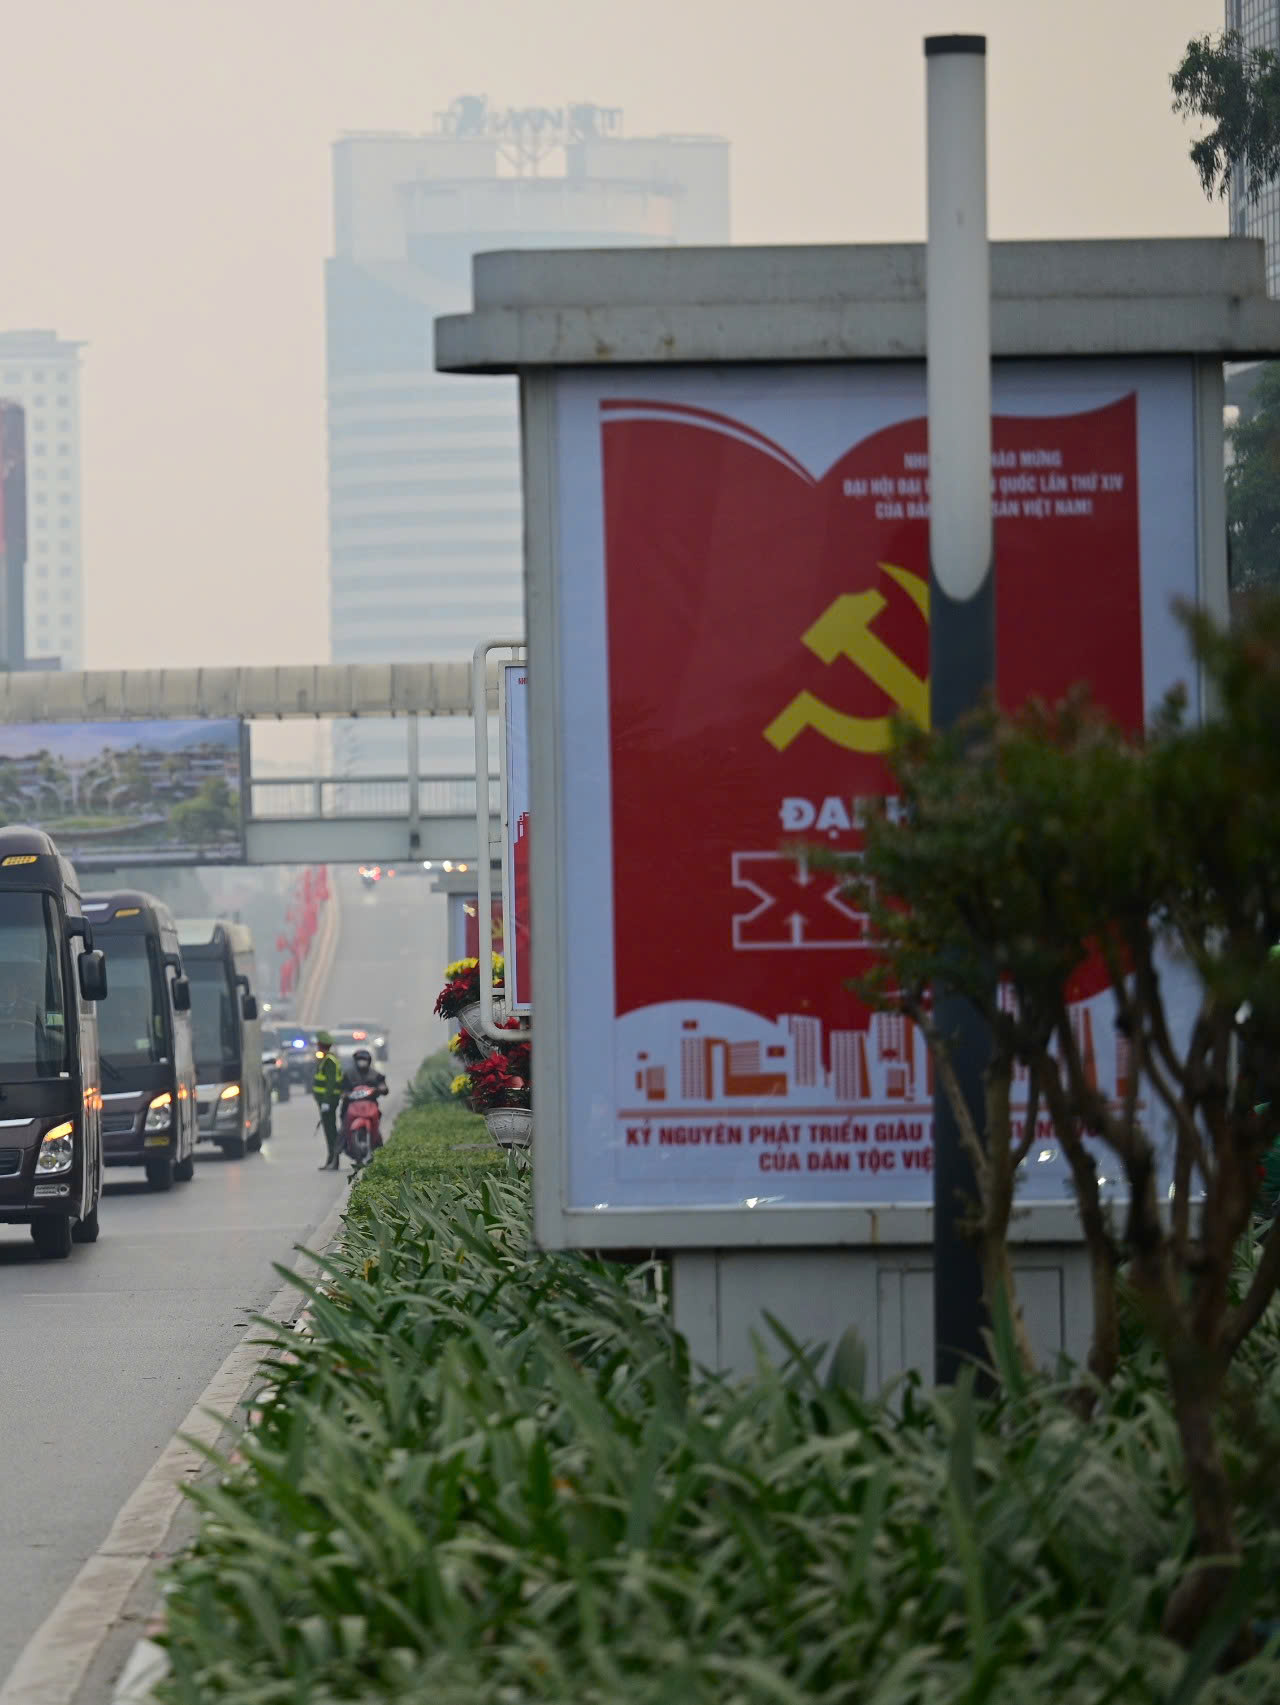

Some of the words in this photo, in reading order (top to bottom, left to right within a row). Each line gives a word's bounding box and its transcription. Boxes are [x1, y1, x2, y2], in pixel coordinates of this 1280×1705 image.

[1101, 473, 1124, 491] XIV
[625, 1118, 652, 1146] KỶ
[659, 1119, 742, 1146] NGUYÊN
[749, 1120, 801, 1145] PHÁT
[808, 1115, 868, 1144] TRIỂN
[875, 1119, 922, 1143] GIÀU
[759, 1144, 801, 1172] CỦA
[807, 1148, 851, 1172] DÂN
[857, 1148, 895, 1174] TỘC
[901, 1148, 934, 1173] VIỆ
